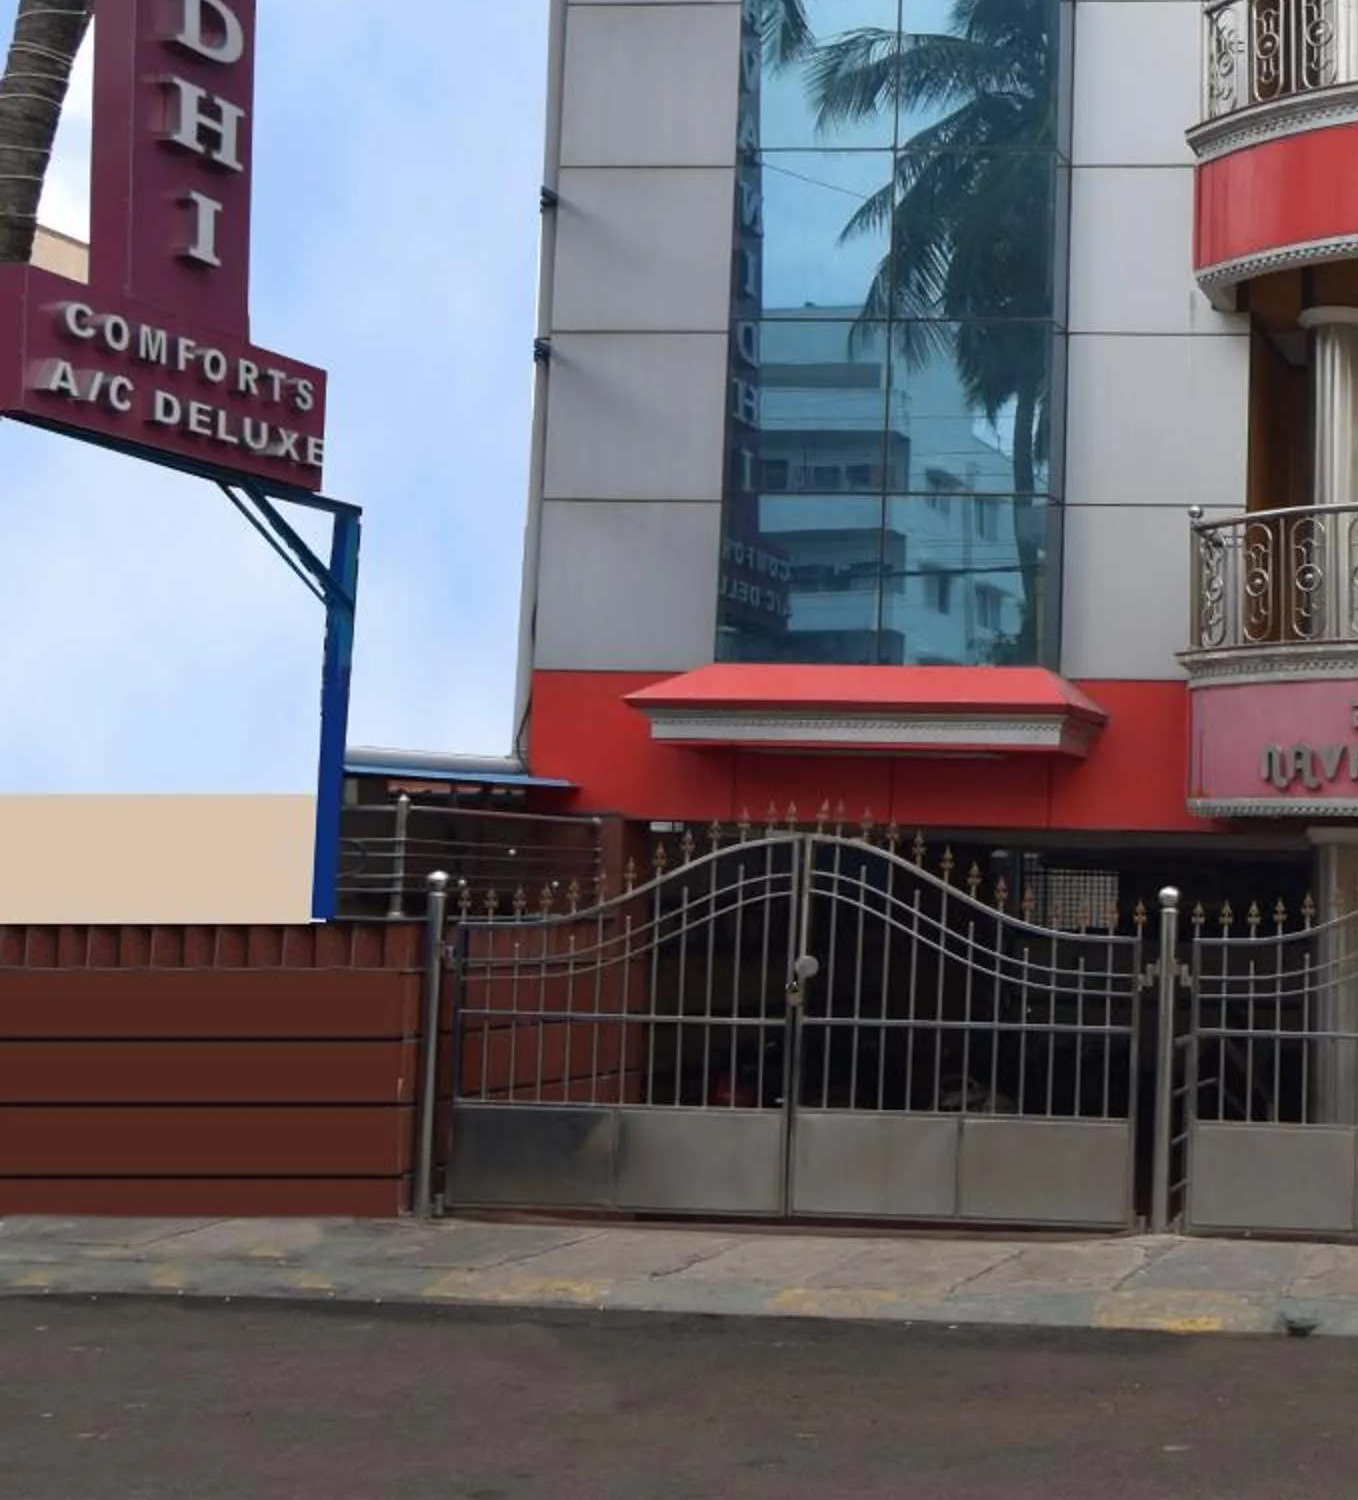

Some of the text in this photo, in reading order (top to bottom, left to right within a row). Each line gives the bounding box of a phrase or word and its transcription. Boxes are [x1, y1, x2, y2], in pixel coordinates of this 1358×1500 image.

[64, 301, 315, 412] COMFORTS
[49, 361, 325, 467] A/C DELUXE
